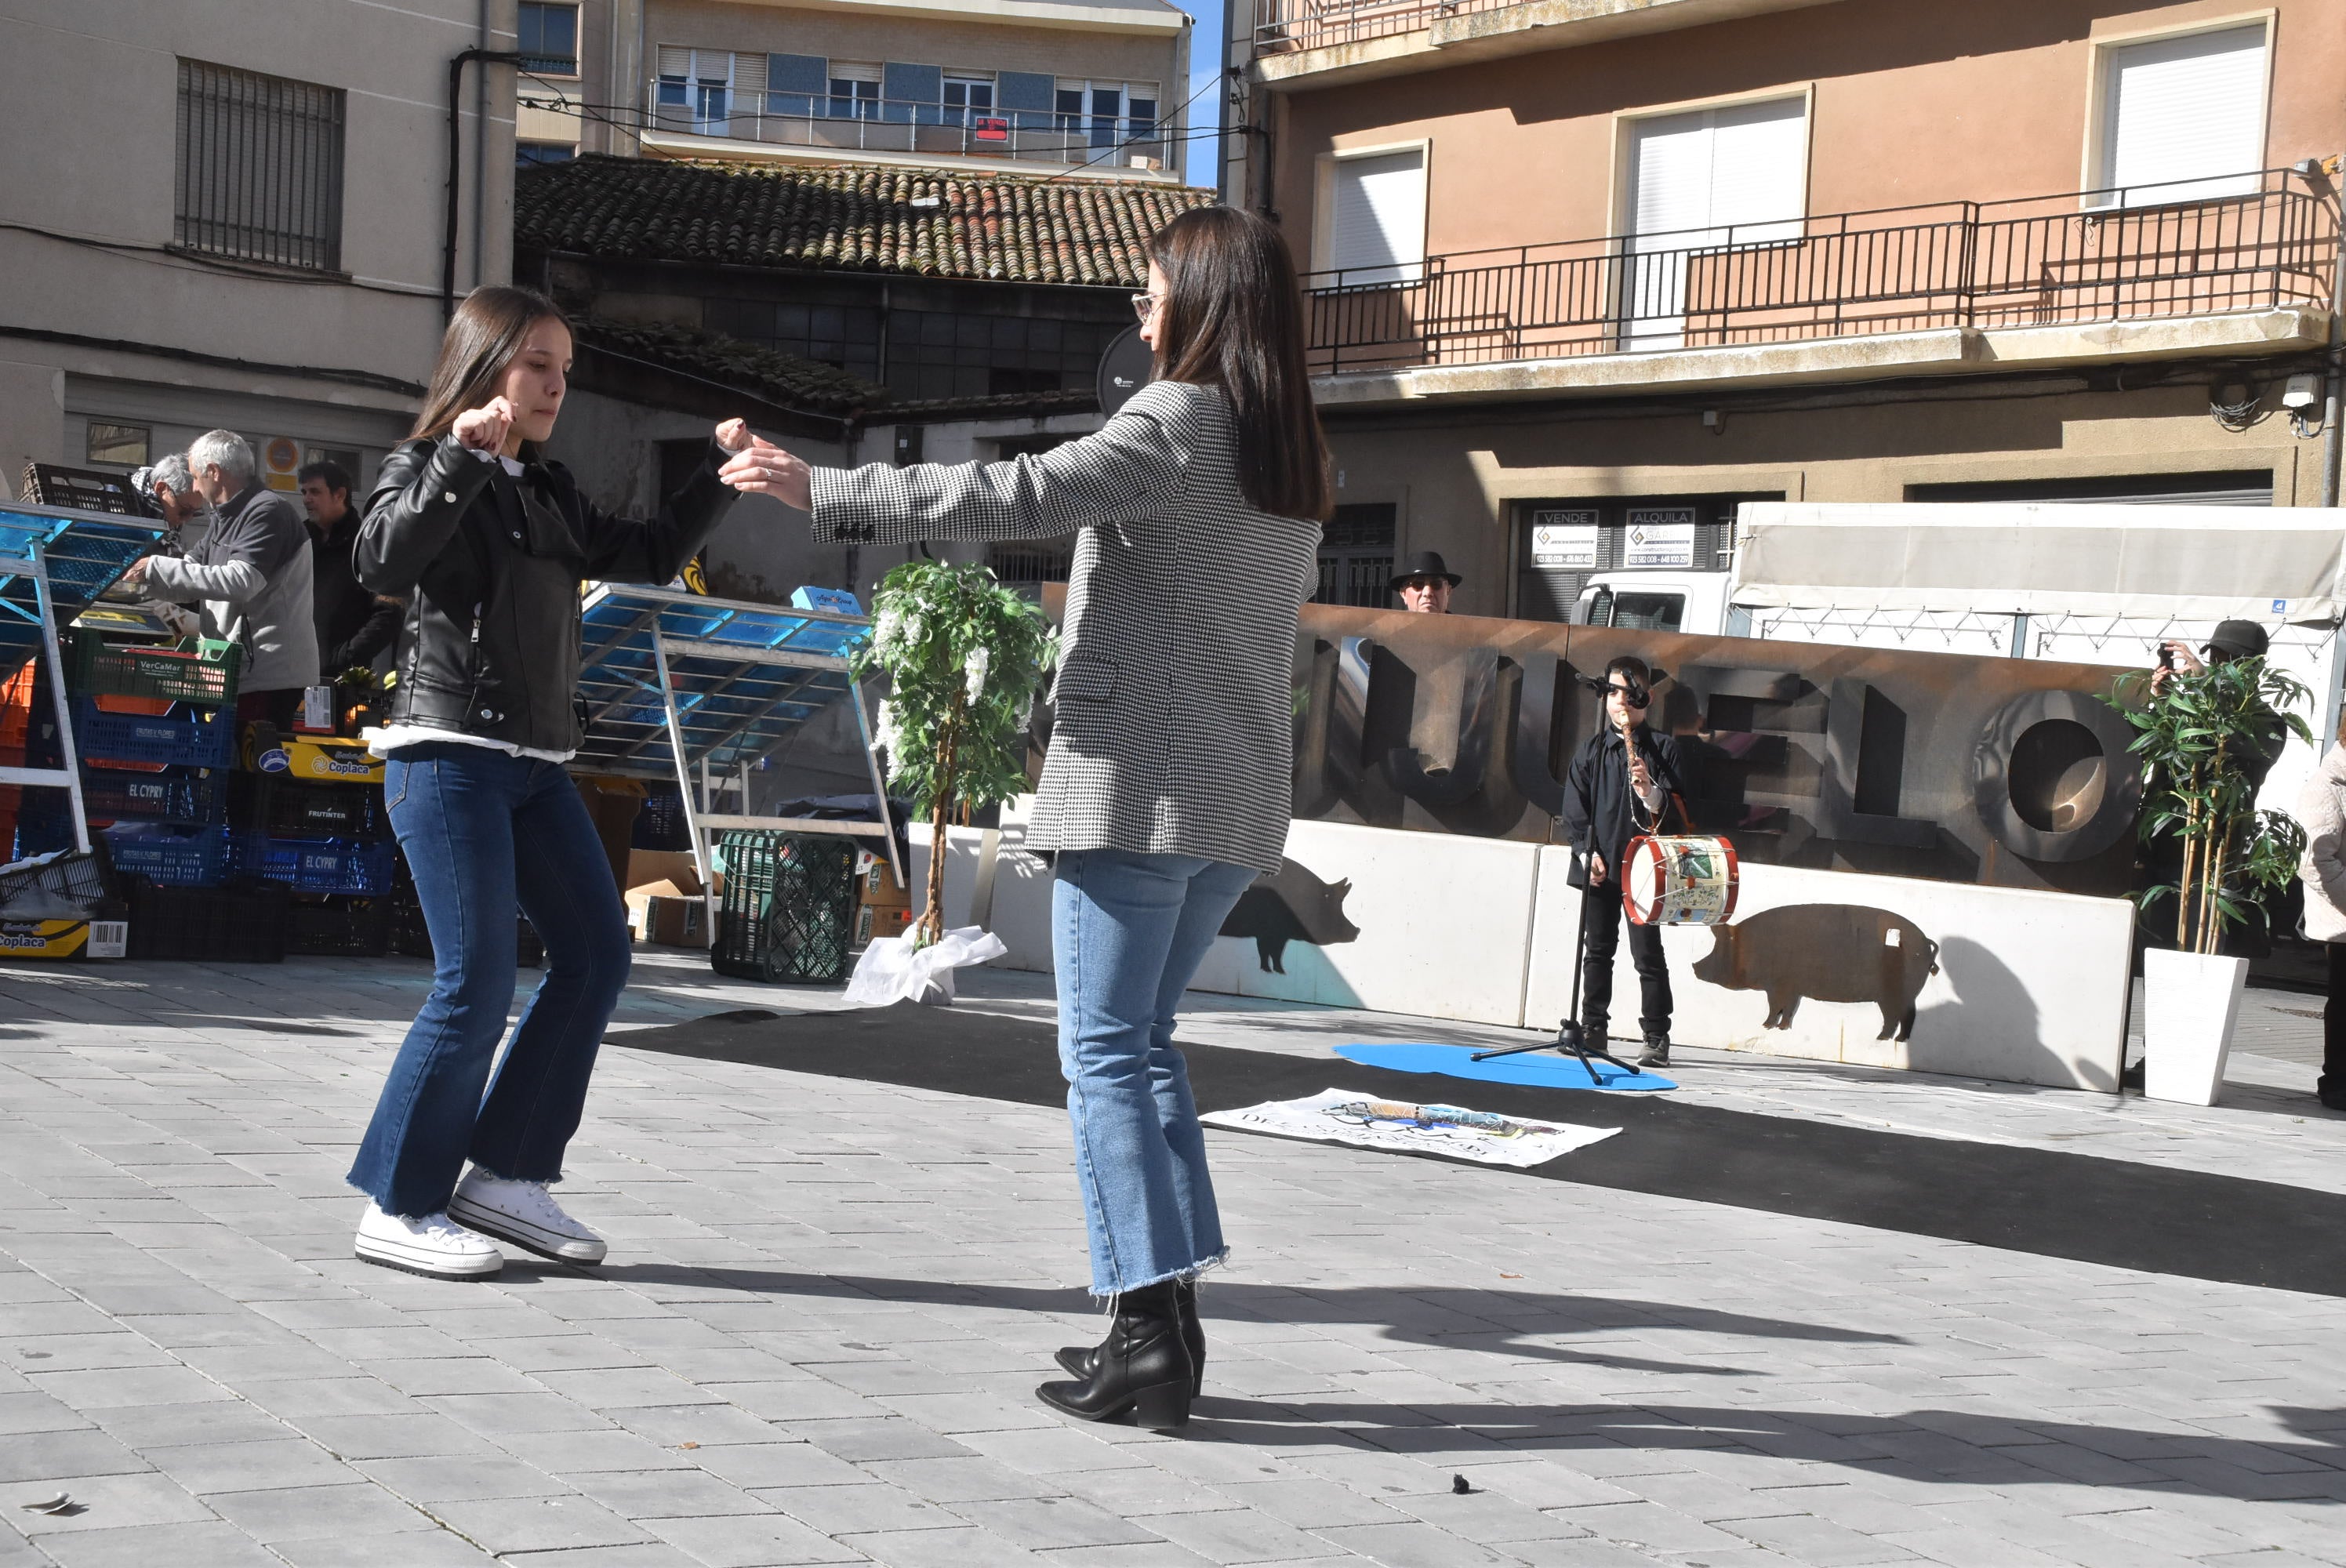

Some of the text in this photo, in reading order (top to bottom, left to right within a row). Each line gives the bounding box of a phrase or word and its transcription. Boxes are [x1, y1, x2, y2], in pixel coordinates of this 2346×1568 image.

[1545, 514, 1588, 523] VENDE
[1634, 512, 1687, 524] ALQUILA
[140, 661, 181, 671] VerCaMar
[1289, 633, 2143, 863] IJUELO
[329, 761, 369, 775] Coplaca
[129, 784, 163, 798] EL CYPRY
[306, 855, 337, 869] EL CYPRY
